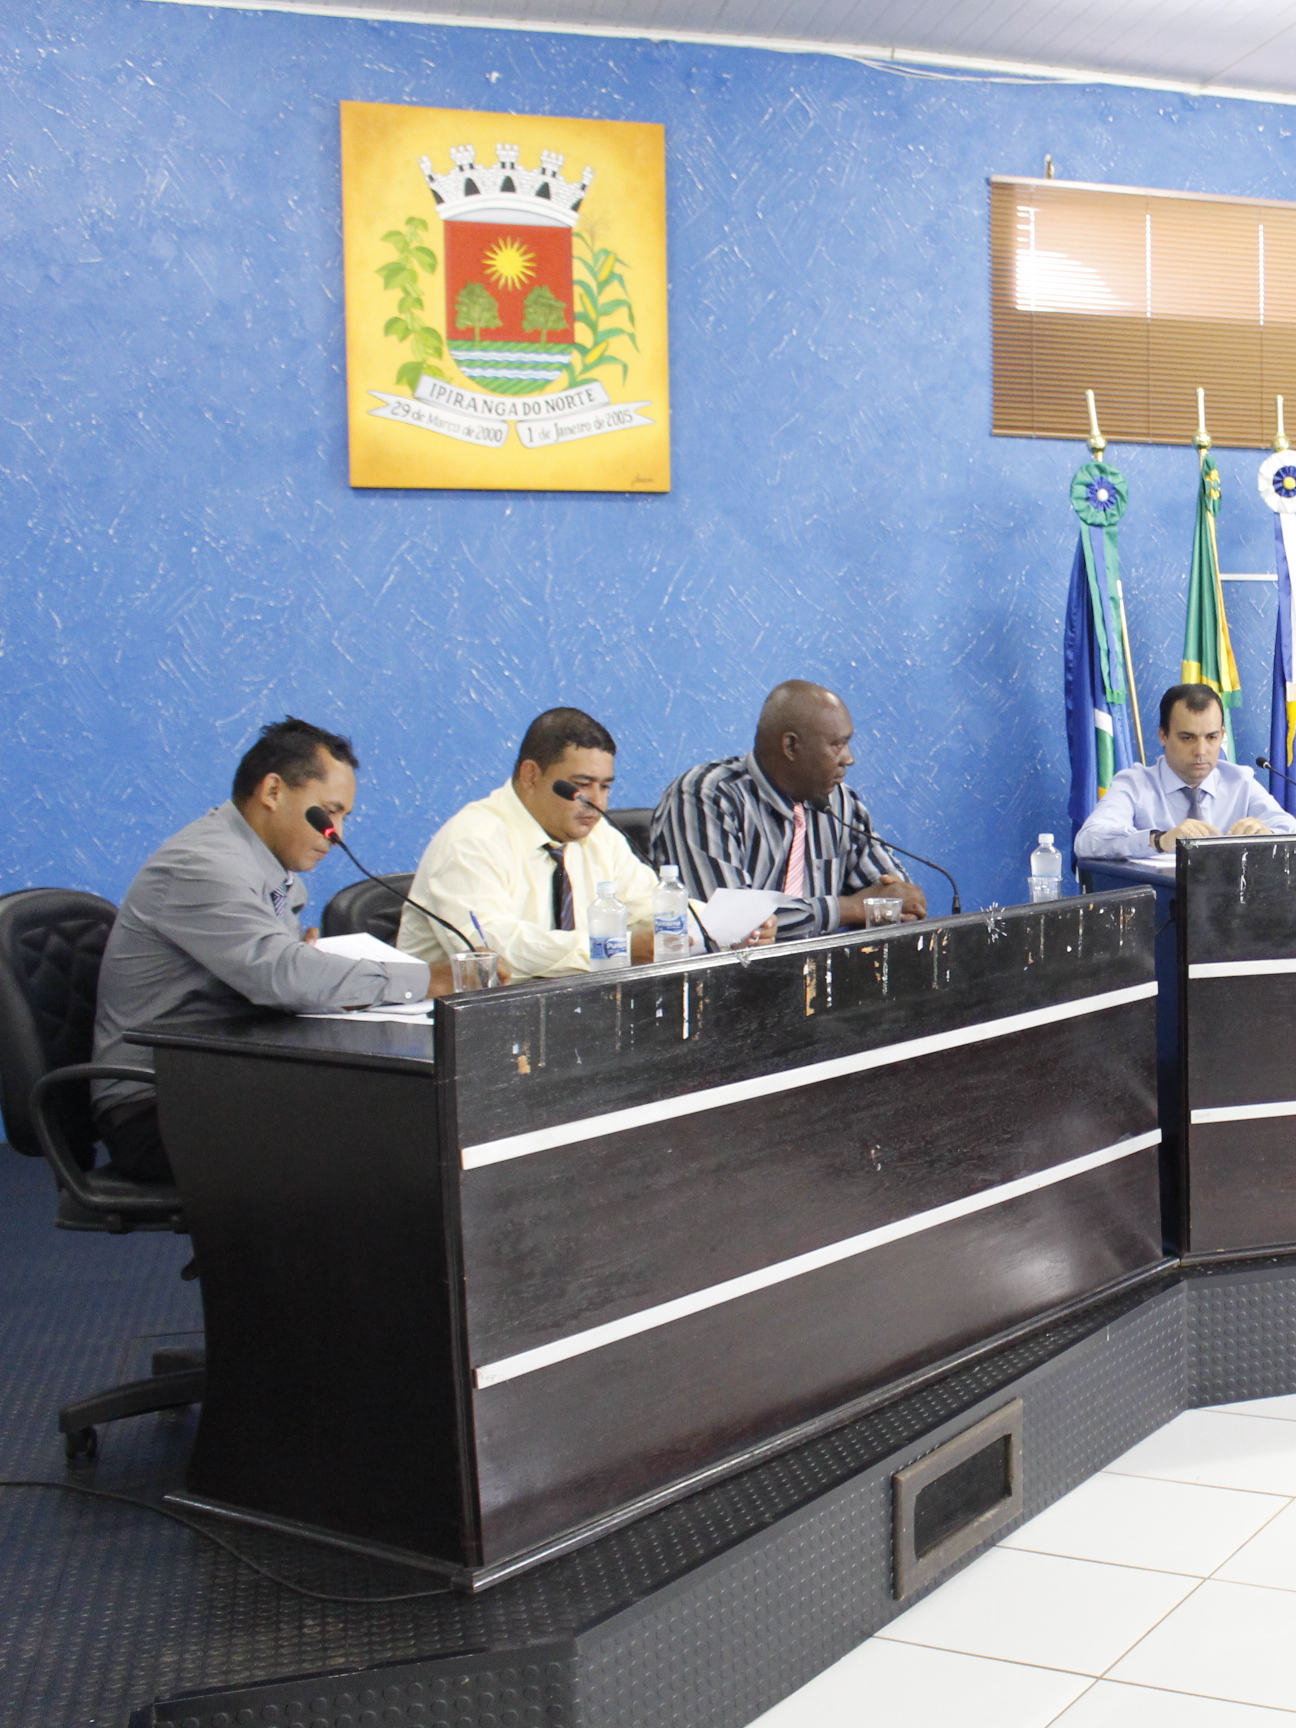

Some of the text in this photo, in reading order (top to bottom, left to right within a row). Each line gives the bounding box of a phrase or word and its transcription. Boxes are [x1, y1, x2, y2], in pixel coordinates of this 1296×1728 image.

[429, 383, 595, 417] IPIRANGA DO NORTE
[390, 401, 411, 418] 29
[411, 410, 425, 421] de
[462, 424, 476, 438] de
[475, 426, 503, 443] 2000
[527, 426, 533, 443] 1
[553, 421, 592, 442] Janeiro
[593, 415, 605, 430] de
[606, 409, 633, 427] 2005
